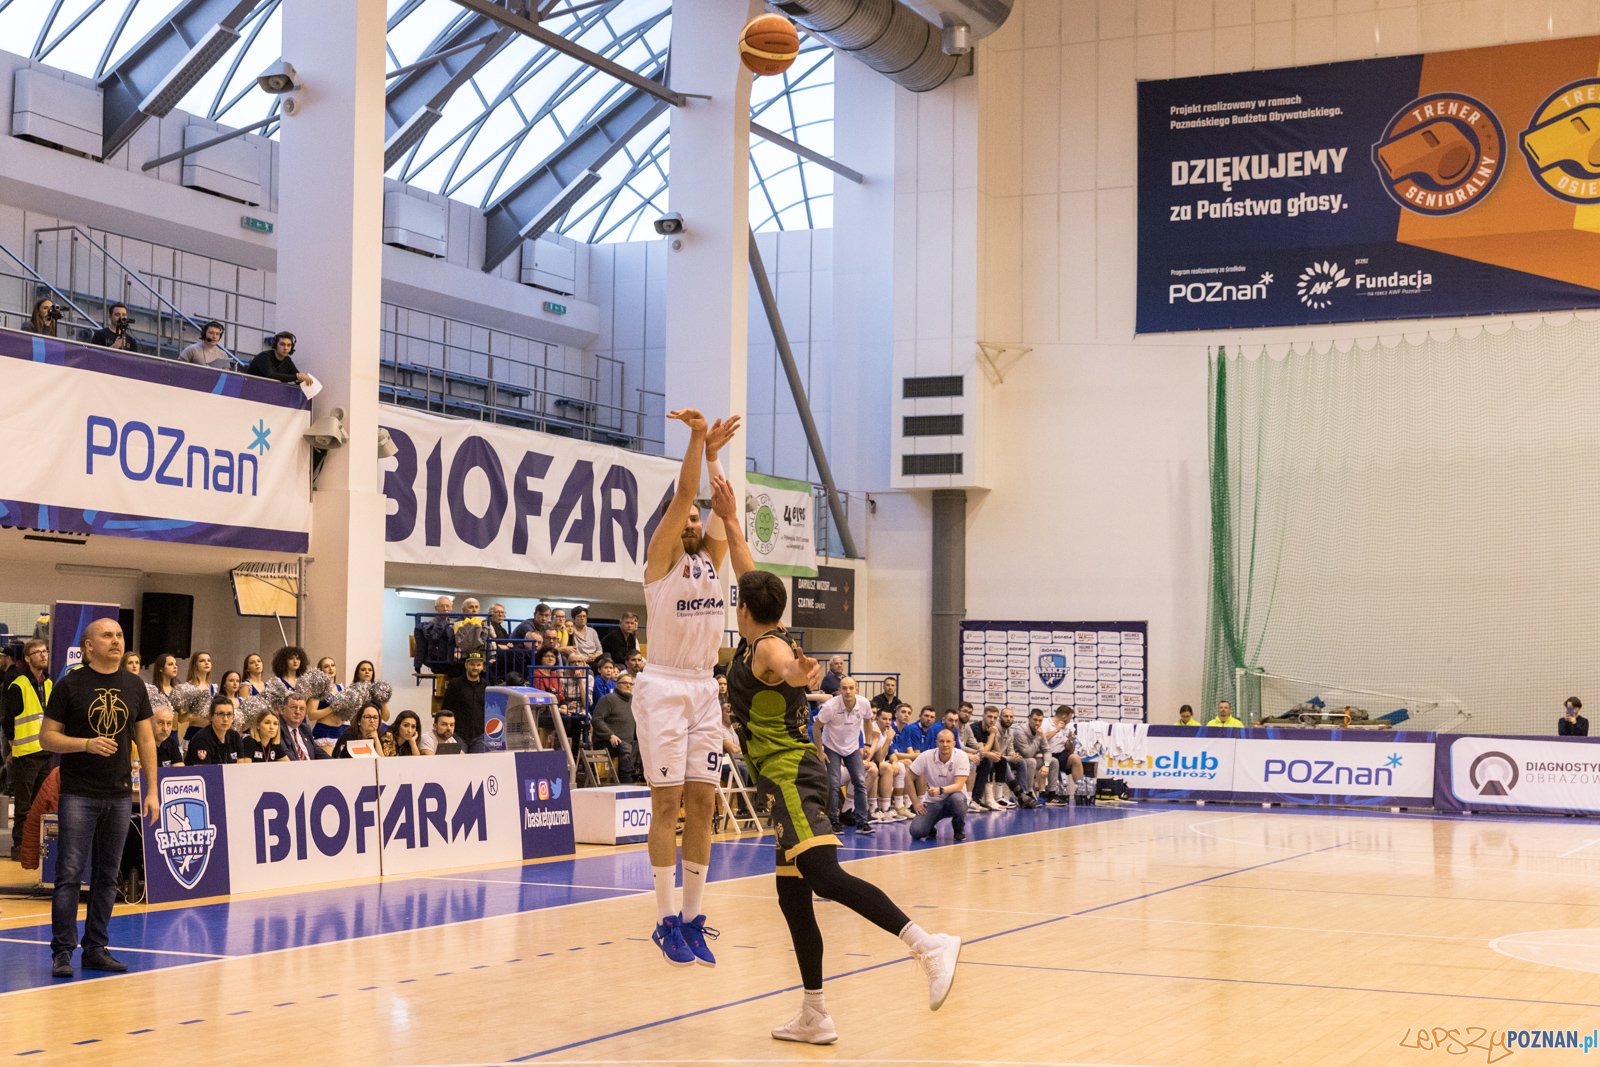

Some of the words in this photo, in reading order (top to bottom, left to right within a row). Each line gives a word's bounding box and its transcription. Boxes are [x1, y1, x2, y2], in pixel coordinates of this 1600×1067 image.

[1170, 104, 1201, 115] Projekt
[1203, 101, 1256, 113] realizowany
[1258, 99, 1266, 107] w
[1268, 95, 1302, 106] ramach
[1561, 87, 1600, 108] TRE
[1170, 117, 1230, 130] Poznańskiego
[1232, 112, 1267, 124] Budżetu
[1269, 106, 1343, 122] Obywatelskiego.
[1412, 102, 1481, 125] TRENER
[1171, 147, 1348, 191] DZIĘKUJEMY
[1405, 155, 1496, 207] SENIORALNY
[1557, 176, 1600, 195] OSIE
[1169, 204, 1191, 222] za
[1197, 197, 1282, 220] Państwa
[1287, 192, 1349, 217] głosy.
[1355, 270, 1433, 289] Fundacja
[707, 752, 723, 773] 97
[1106, 768, 1147, 776] biuro
[1152, 770, 1217, 780] podróży
[166, 784, 200, 795] BIOFARM
[157, 829, 214, 849] BASKET
